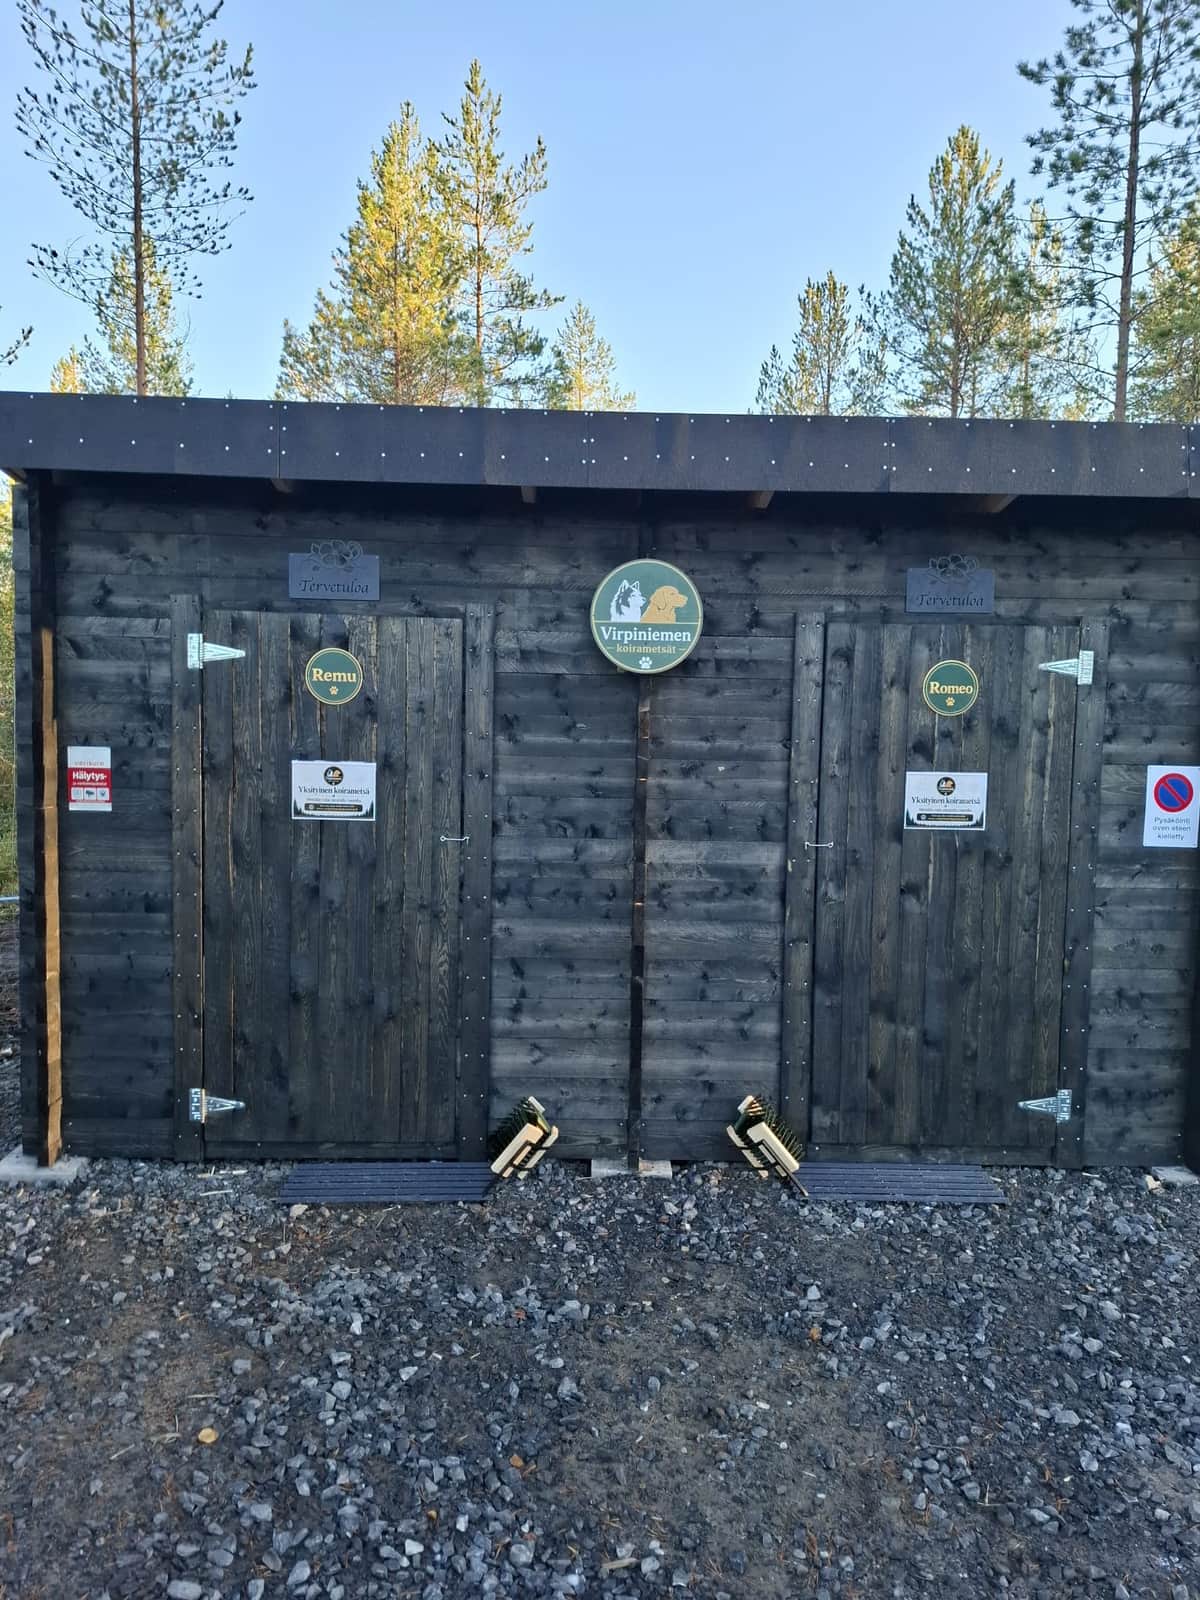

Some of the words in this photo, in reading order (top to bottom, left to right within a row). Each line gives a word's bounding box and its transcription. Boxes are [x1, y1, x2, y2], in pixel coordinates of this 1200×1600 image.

[299, 577, 369, 594] Tervetuloa
[918, 592, 984, 608] Tervetuloa
[600, 626, 691, 644] Virpiniemen
[616, 644, 676, 654] koirametsät
[312, 668, 356, 682] Remu
[930, 681, 973, 694] Romeo
[72, 769, 107, 782] Hälytys-
[298, 785, 333, 796] Yksityinen
[911, 796, 945, 805] Yksityinen
